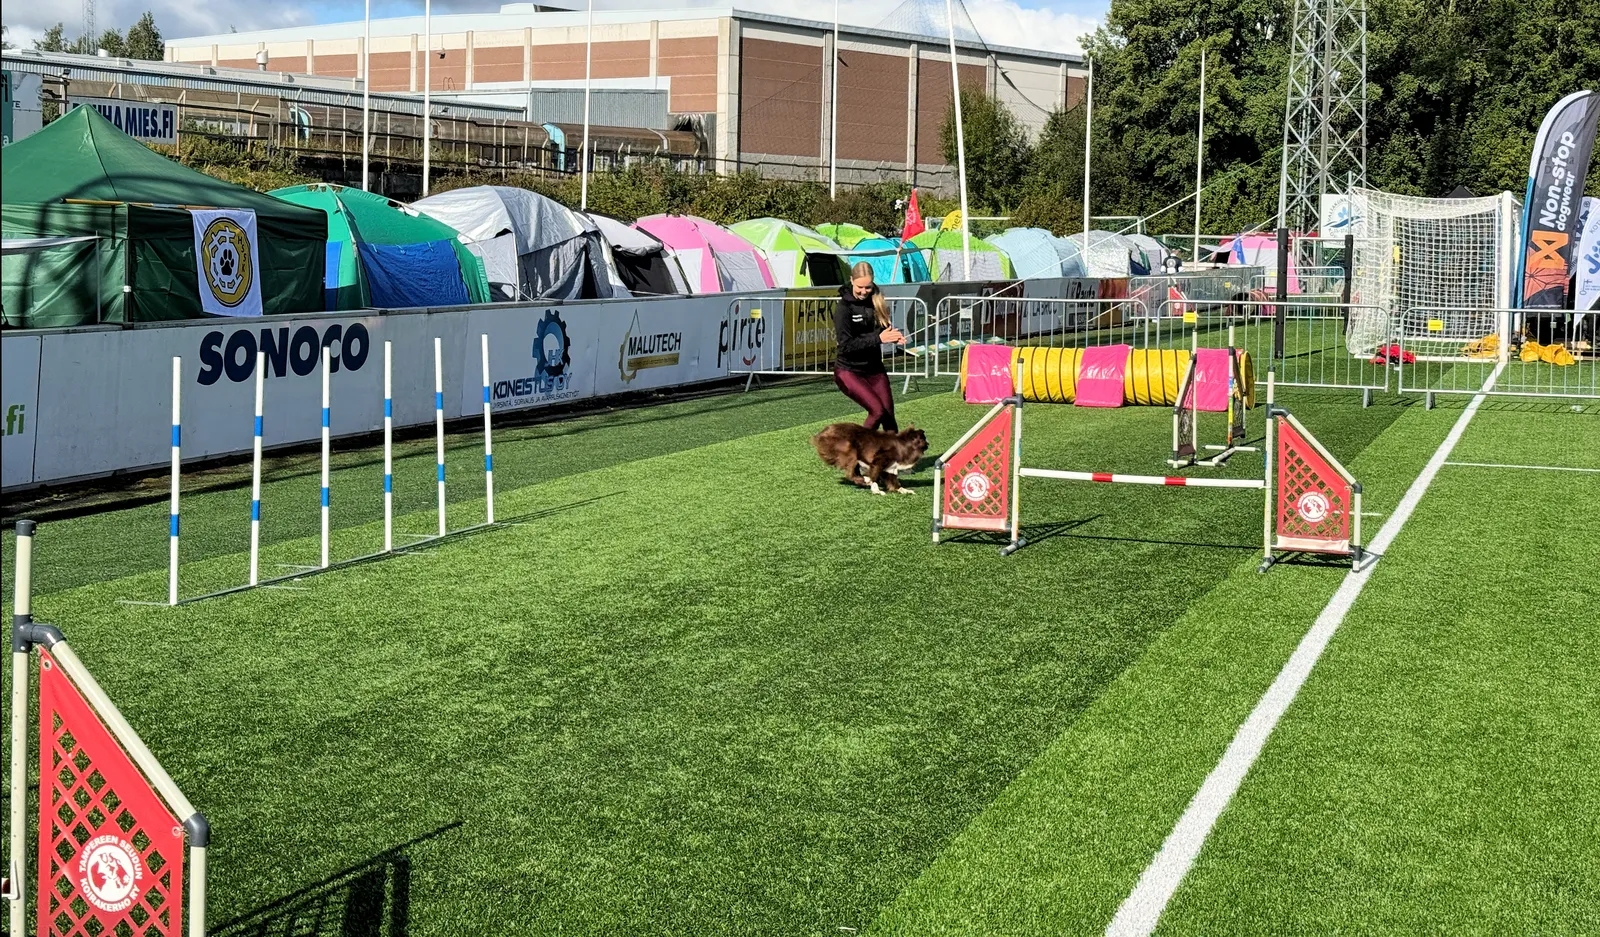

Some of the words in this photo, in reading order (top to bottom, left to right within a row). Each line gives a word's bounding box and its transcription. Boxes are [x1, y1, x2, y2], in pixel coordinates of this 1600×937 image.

[1539, 131, 1576, 229] Non-stop
[1555, 171, 1576, 231] dogwear
[197, 323, 370, 386] SONOCO
[628, 332, 682, 357] MALUTECH
[493, 376, 555, 401] KONEISTUS
[556, 372, 573, 391] OY
[79, 835, 119, 873] TAMPEREEN
[119, 839, 143, 880] SEUDUN
[80, 878, 131, 912] KOIRAKERHO
[129, 885, 140, 900] RY
